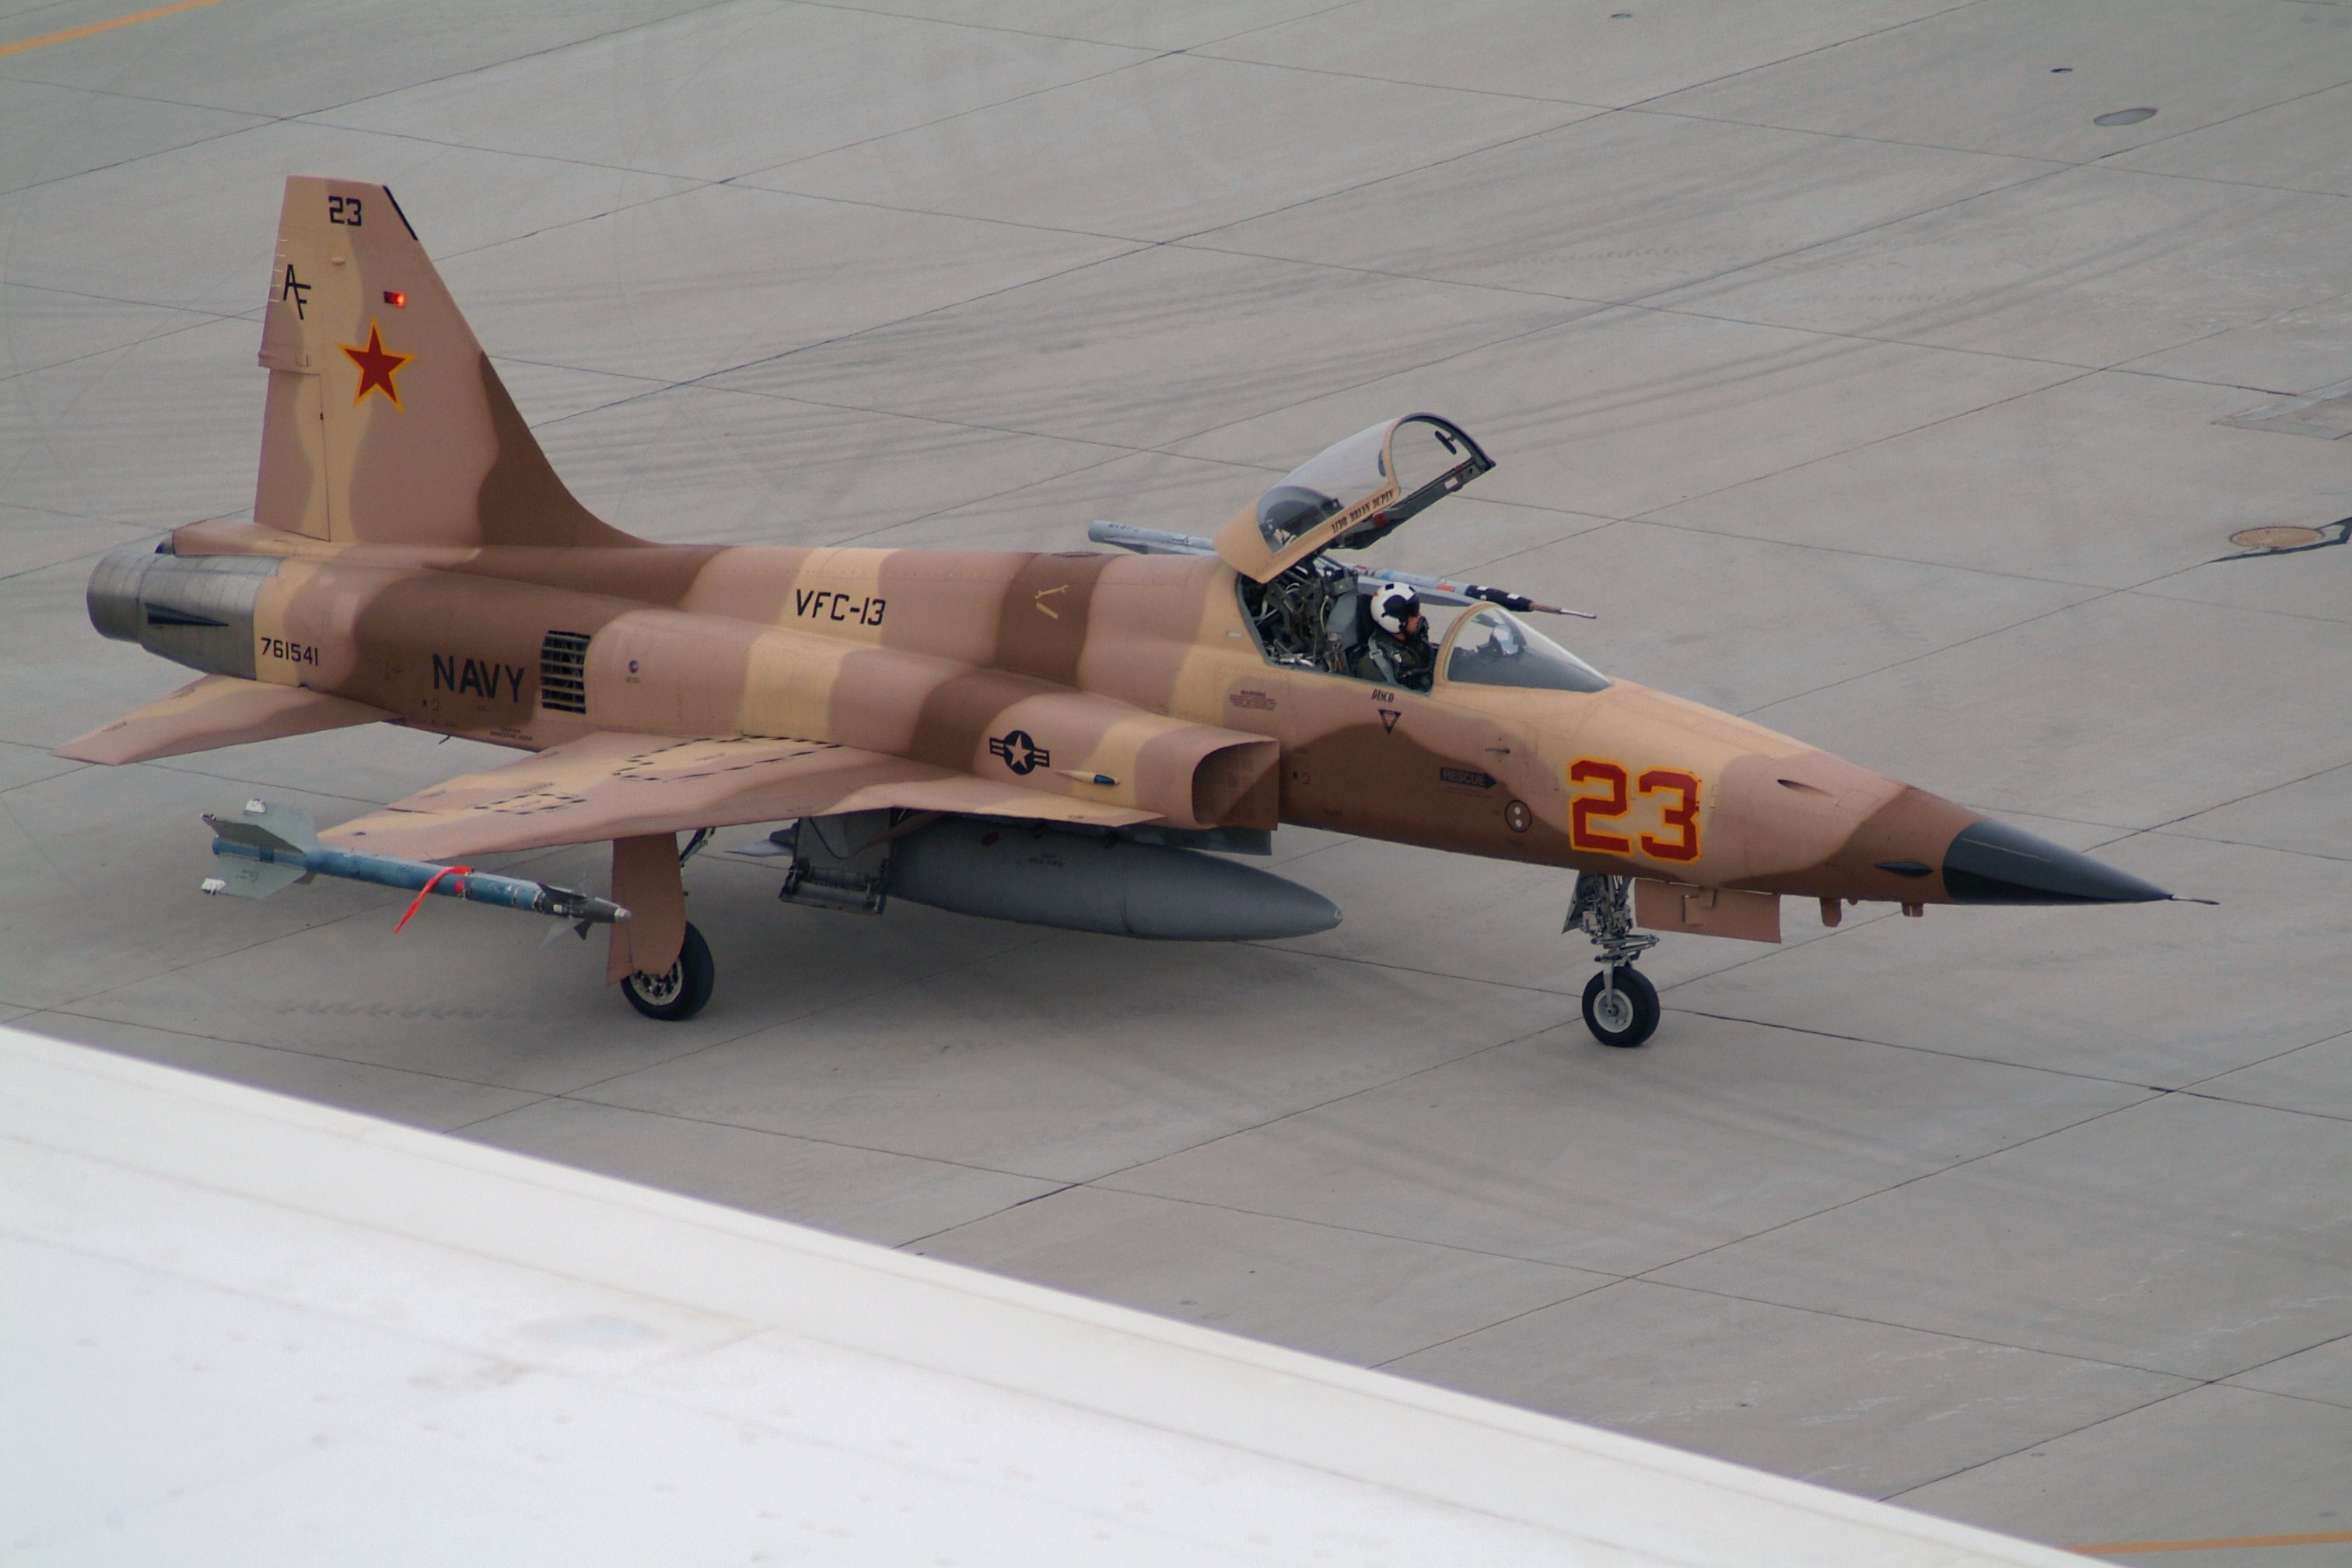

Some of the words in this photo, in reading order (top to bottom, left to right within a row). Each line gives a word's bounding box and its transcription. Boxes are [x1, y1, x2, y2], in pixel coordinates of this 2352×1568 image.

[328, 195, 362, 226] 23
[796, 588, 887, 626] VFC-13
[261, 637, 319, 667] 761541
[432, 653, 525, 703] NAVY
[1371, 688, 1395, 703] DISCO
[1443, 769, 1486, 786] RESCUE
[1568, 758, 1703, 865] 23
